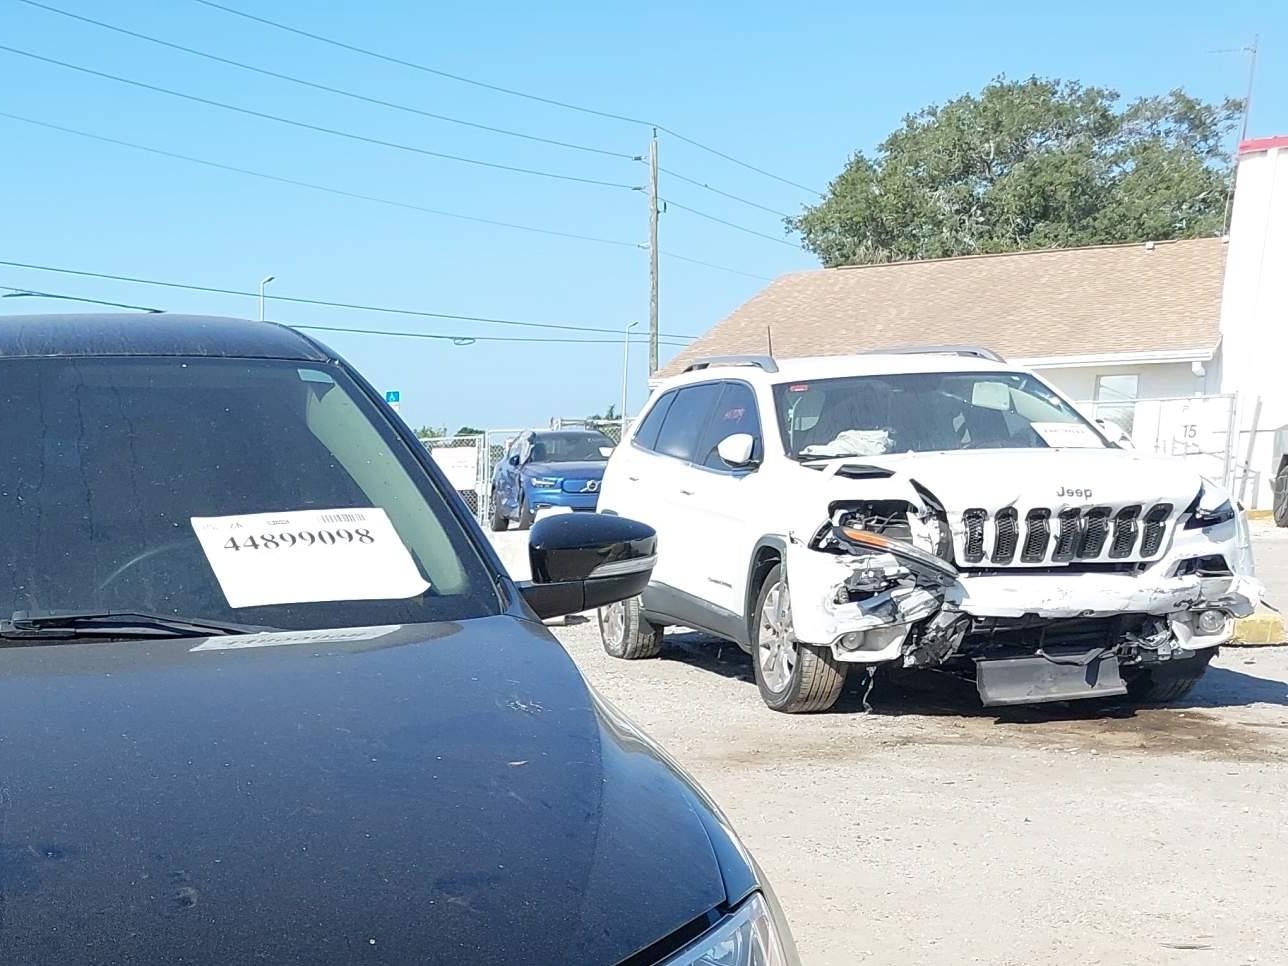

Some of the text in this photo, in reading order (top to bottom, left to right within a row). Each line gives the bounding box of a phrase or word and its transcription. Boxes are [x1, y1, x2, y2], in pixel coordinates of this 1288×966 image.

[1183, 424, 1198, 439] 15
[1055, 485, 1093, 500] Jeep
[223, 527, 376, 552] 44899098
